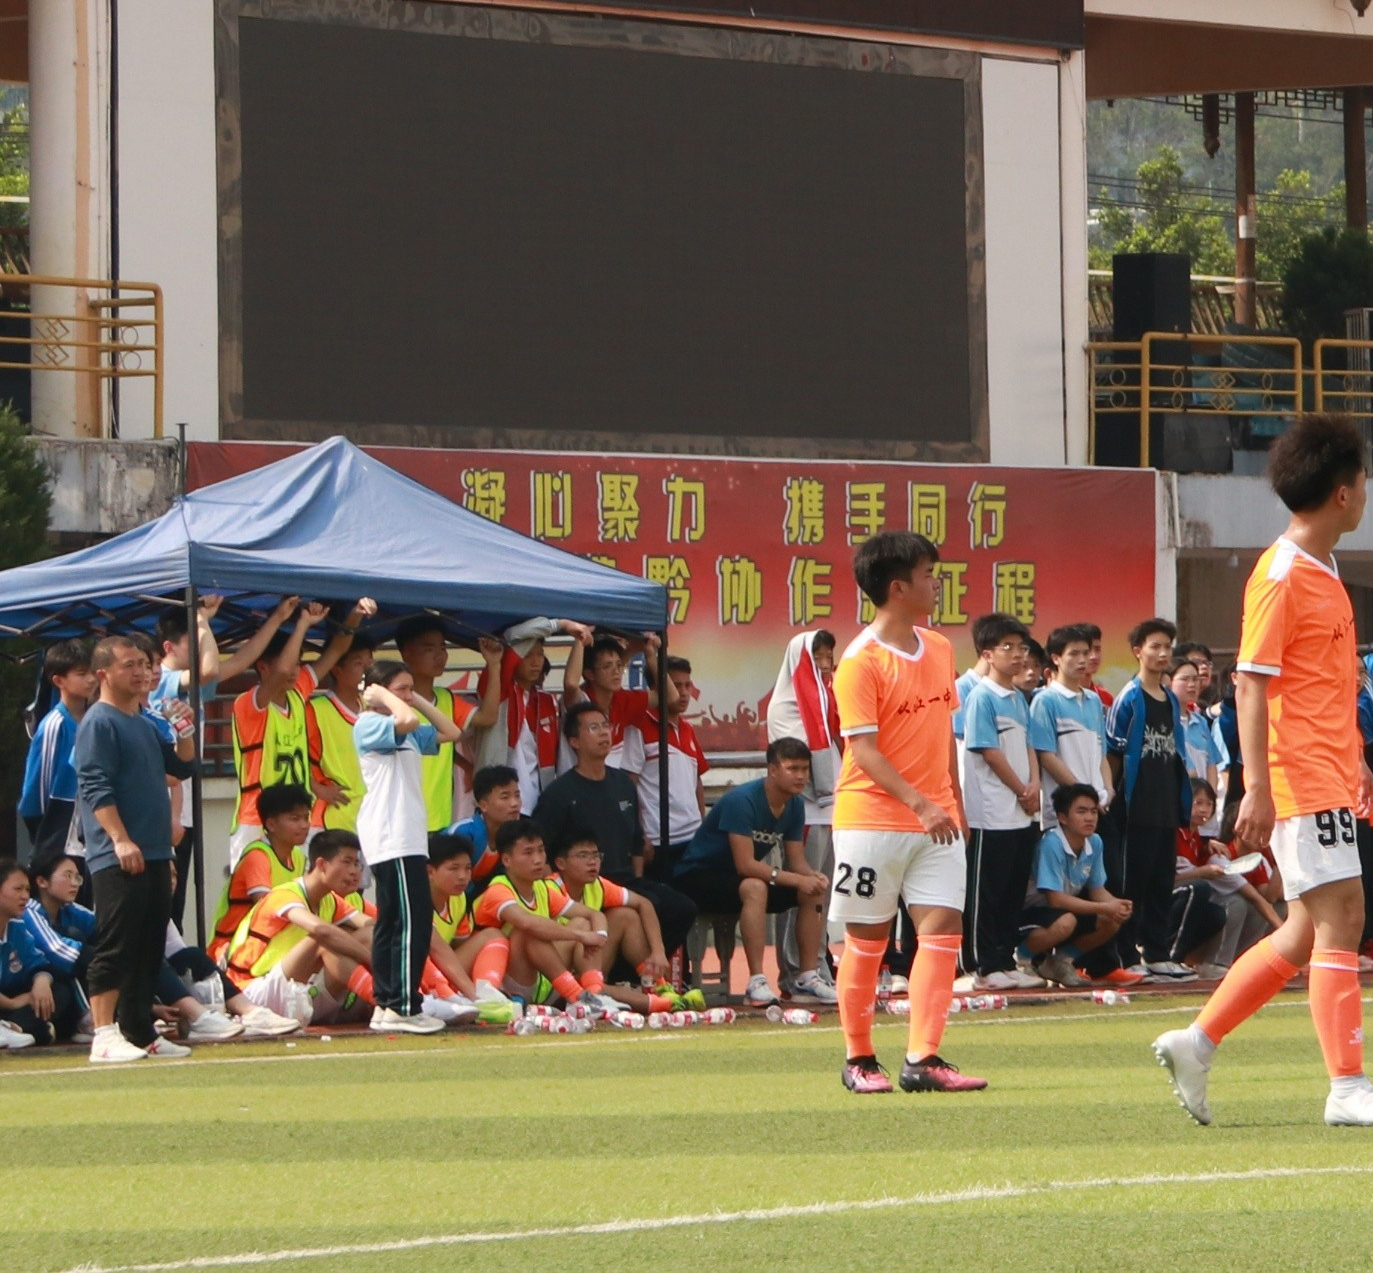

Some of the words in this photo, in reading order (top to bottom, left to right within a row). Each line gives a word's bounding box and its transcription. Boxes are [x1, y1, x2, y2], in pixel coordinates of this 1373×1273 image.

[461, 468, 706, 543] 凝心聚力
[782, 476, 1006, 550] 携手同行
[1315, 808, 1356, 849] 99
[835, 862, 877, 899] 28
